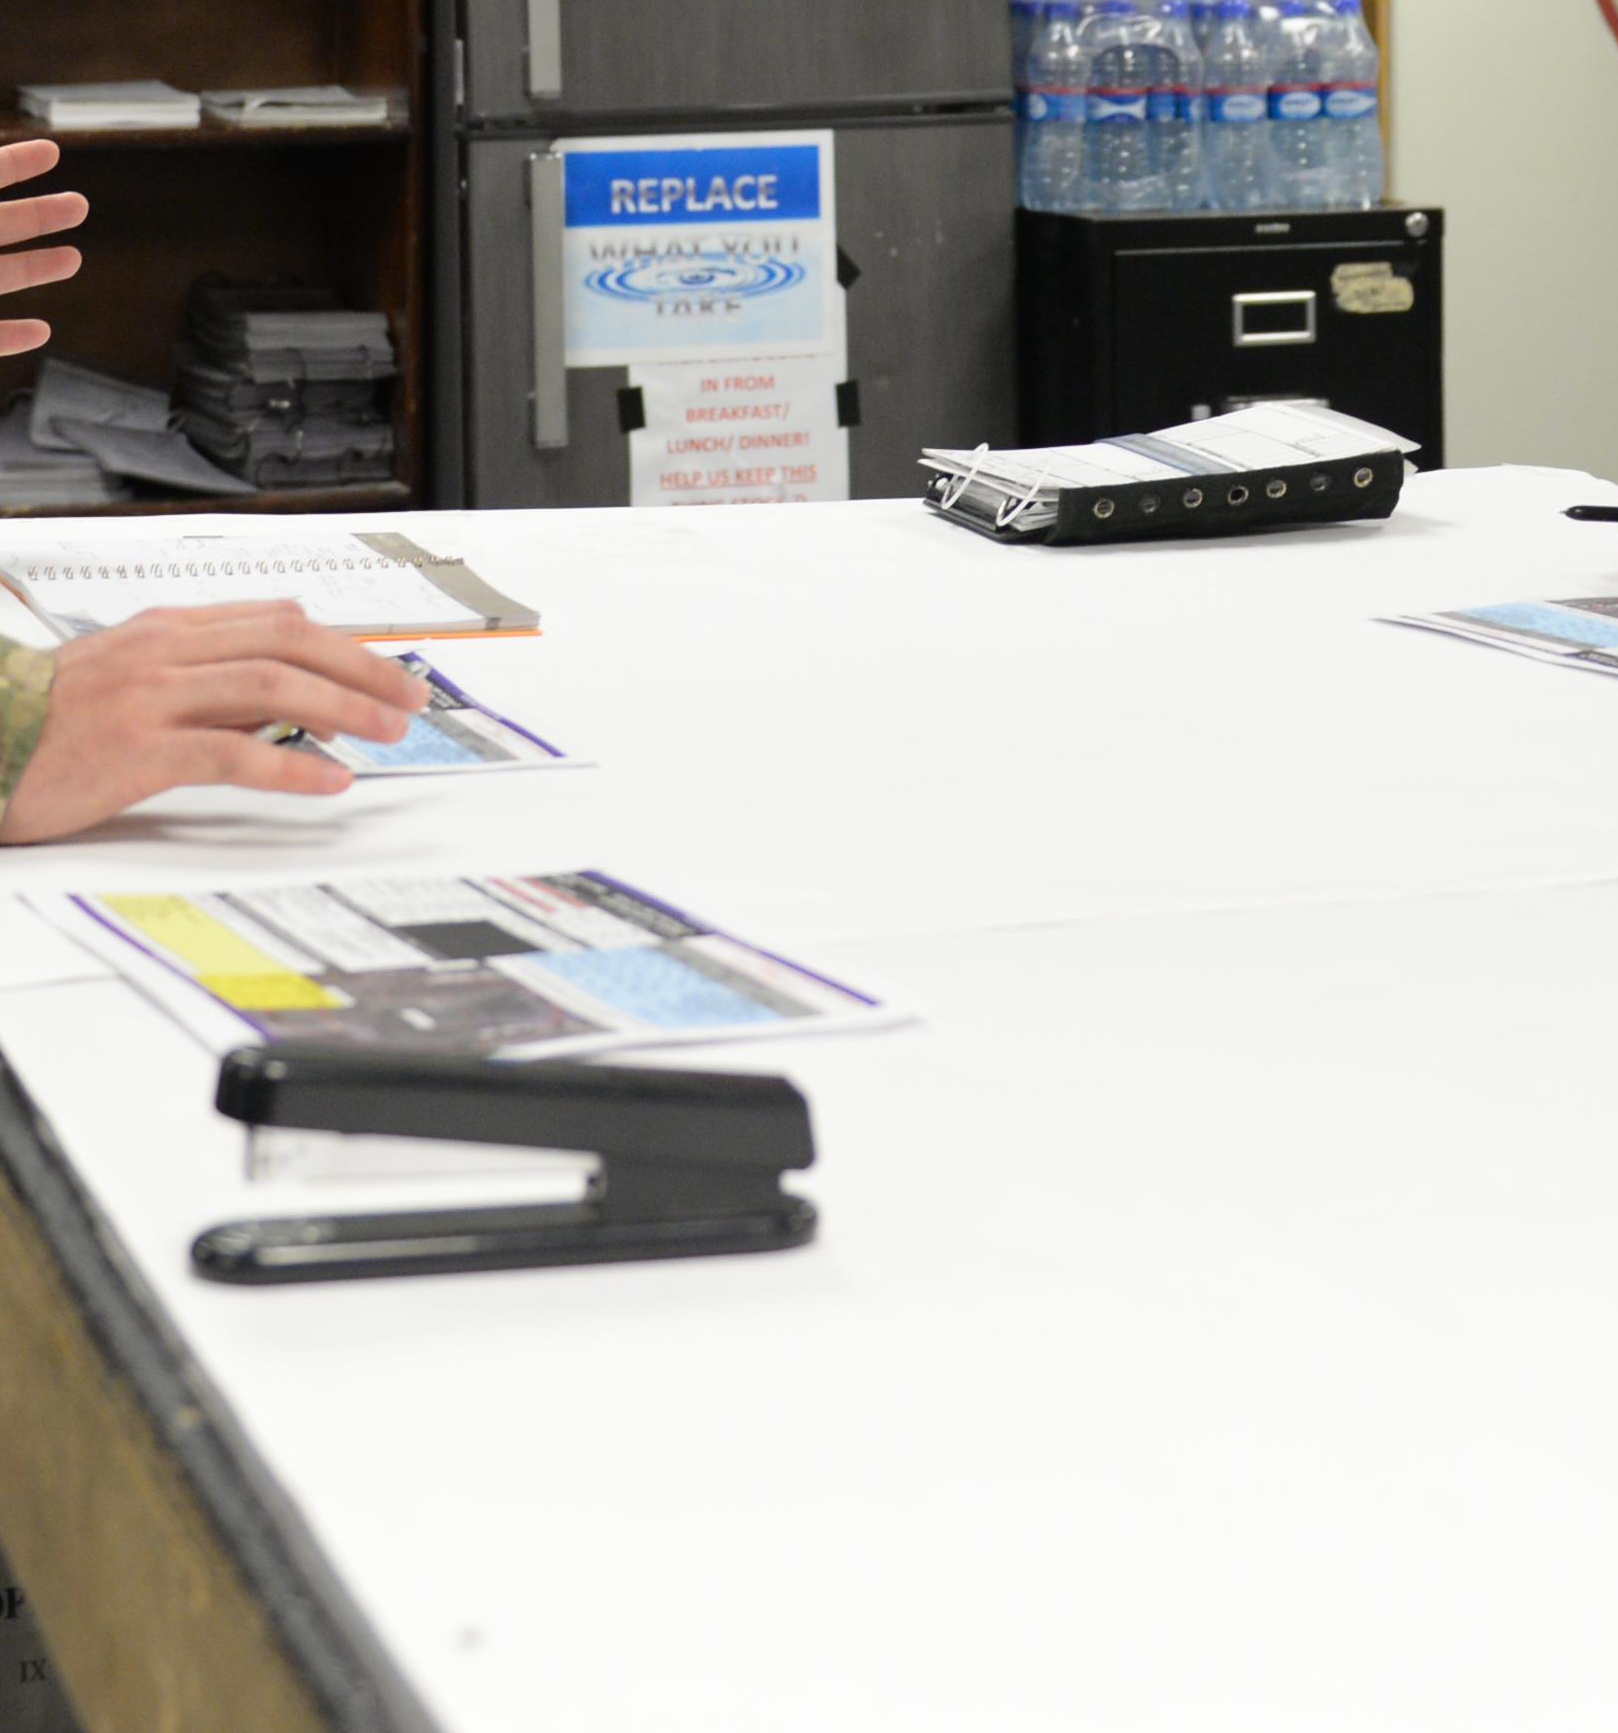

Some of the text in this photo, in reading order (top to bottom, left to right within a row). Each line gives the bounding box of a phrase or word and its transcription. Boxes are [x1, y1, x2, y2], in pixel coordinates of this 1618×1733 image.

[610, 174, 778, 214] REPLACE
[699, 375, 776, 393] IN FROM
[685, 402, 791, 423] BREAKFAST/
[665, 433, 734, 455] LUNCH/
[659, 465, 817, 489] HELP US KEEP THIS
